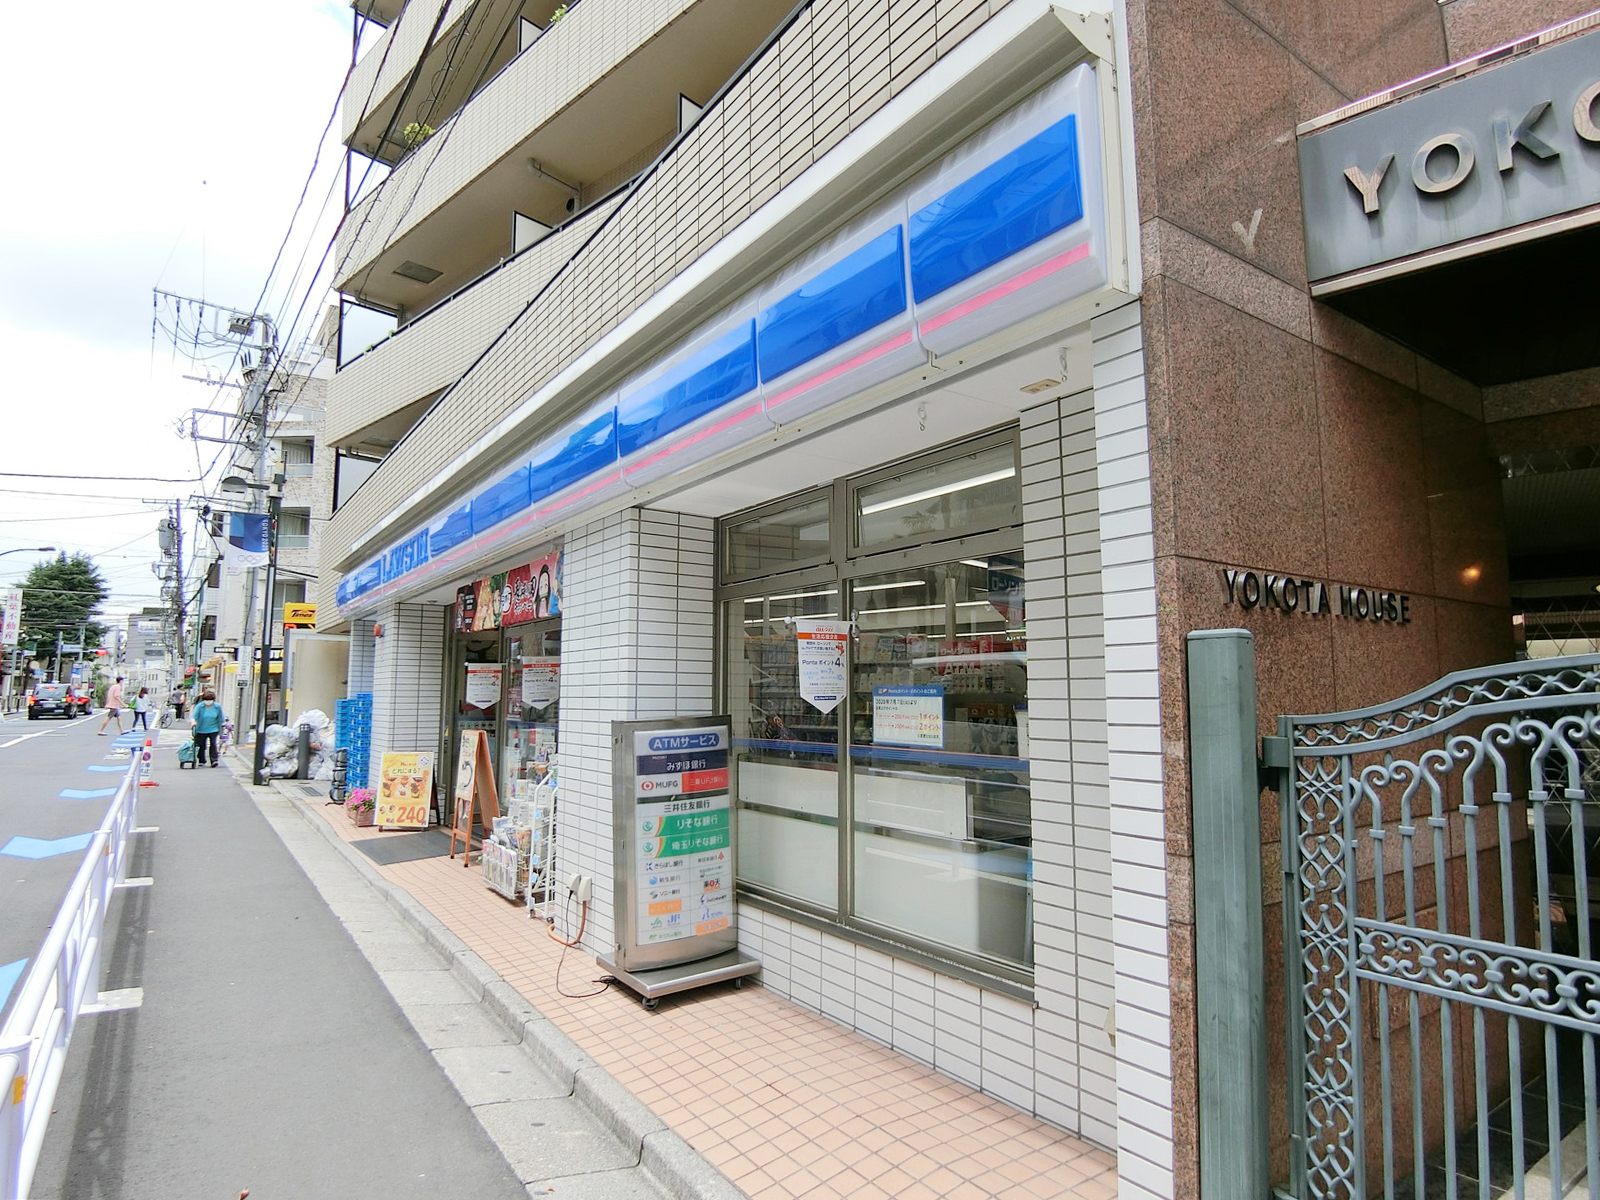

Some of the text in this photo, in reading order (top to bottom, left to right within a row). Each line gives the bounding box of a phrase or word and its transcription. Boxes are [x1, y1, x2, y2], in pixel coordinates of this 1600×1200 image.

[382, 528, 430, 584] LAWSON
[1222, 568, 1411, 624] YOKOTA HOUSE
[291, 609, 315, 618] Times
[919, 723, 940, 731] 2ポイント
[653, 735, 717, 749] ATMサービス
[666, 759, 707, 771] みずほ銀行
[655, 780, 679, 789] MUFG
[664, 800, 711, 813] 三井住友銀行
[396, 806, 426, 823] 240
[677, 815, 719, 830] りそな銀行
[672, 835, 724, 850] 埼玉りそな銀行
